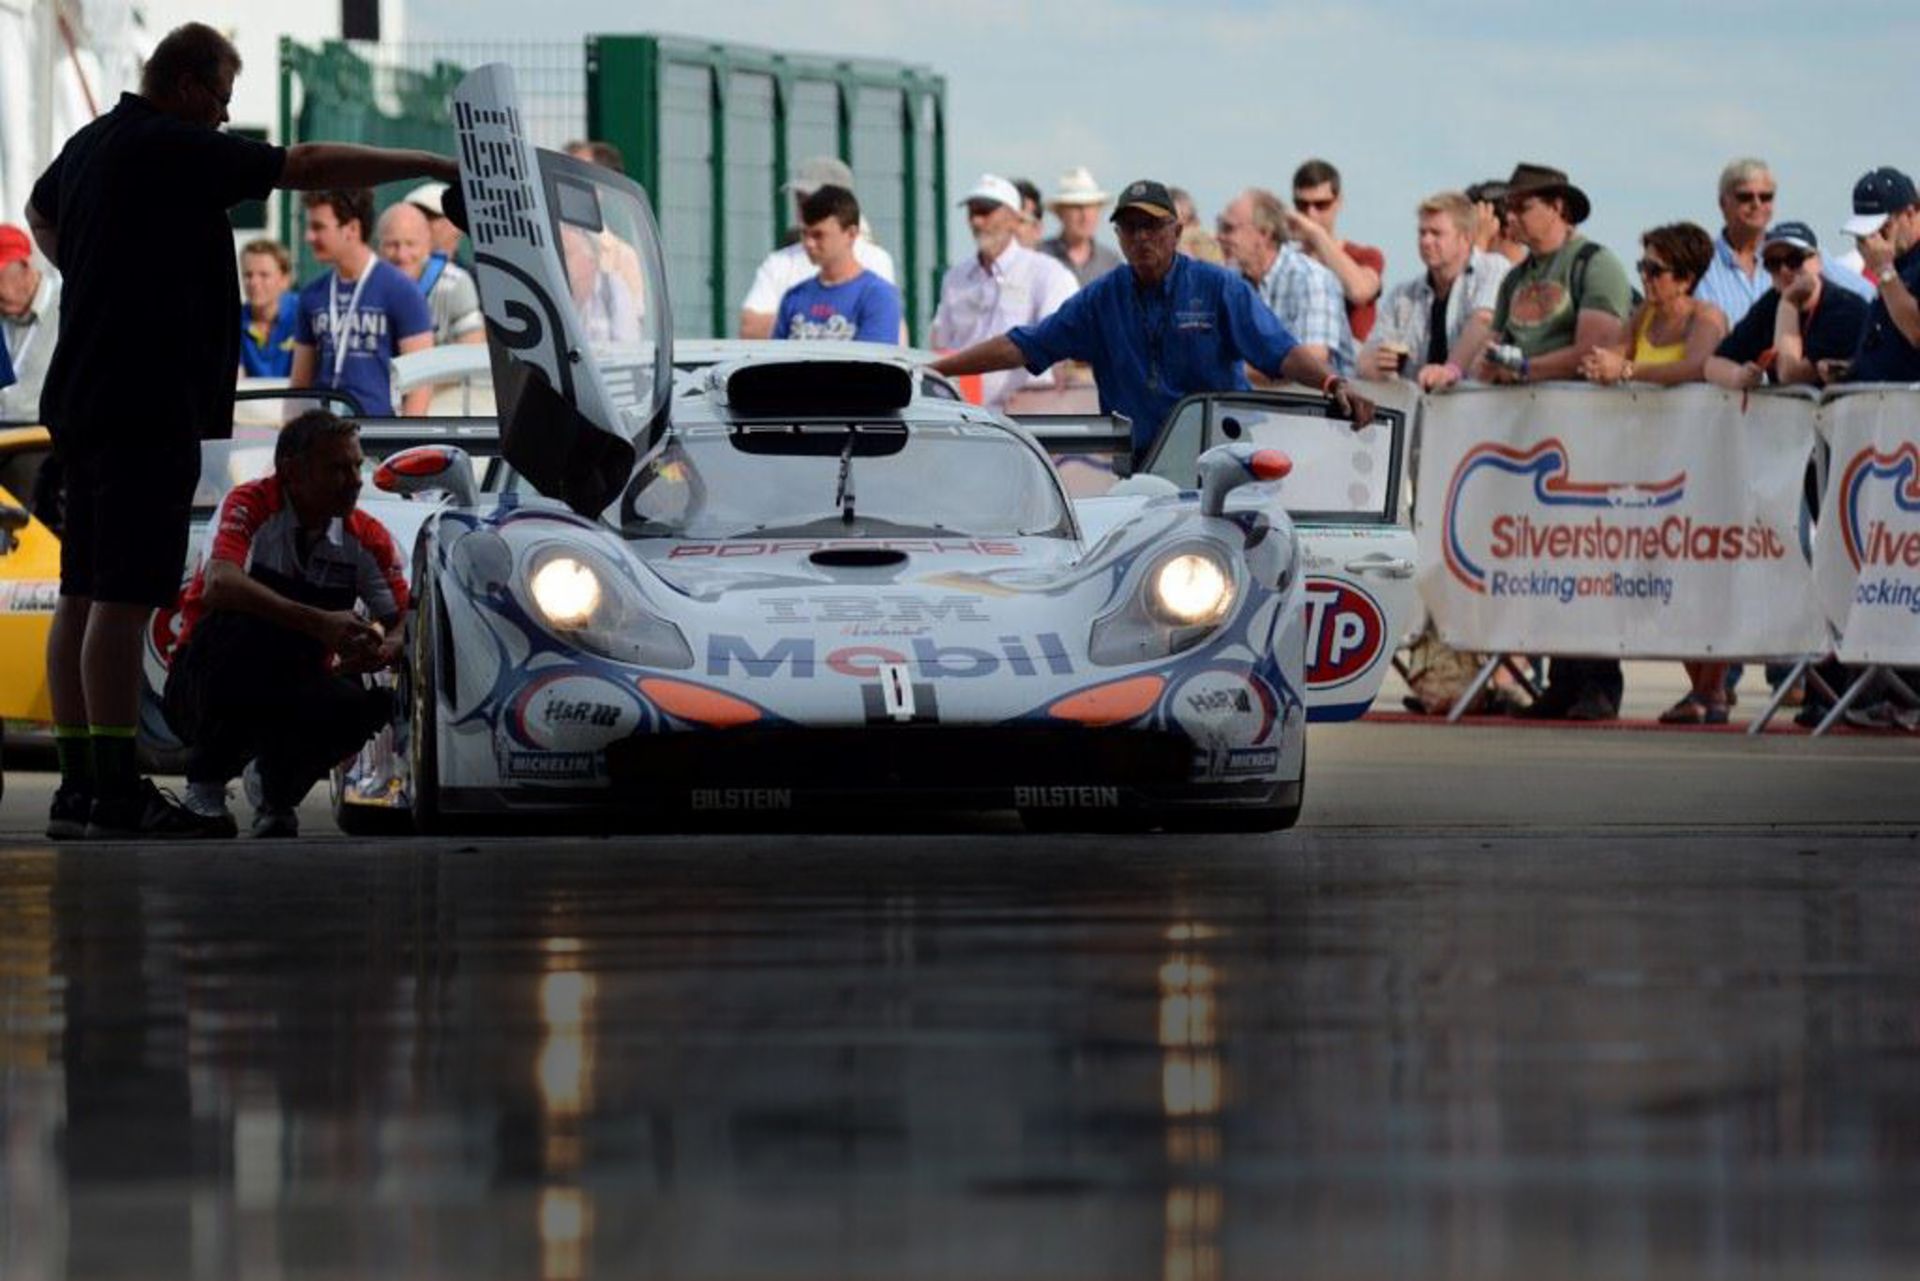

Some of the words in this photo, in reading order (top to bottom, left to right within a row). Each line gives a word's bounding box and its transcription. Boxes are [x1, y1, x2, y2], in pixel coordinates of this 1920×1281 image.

[456, 102, 544, 247] IBM
[1491, 513, 1786, 560] SilverstoneClassic
[758, 596, 990, 623] IBM
[706, 632, 1075, 679] Mobil
[690, 787, 793, 810] BILSTEIN
[1014, 784, 1120, 808] BILSTEIN
